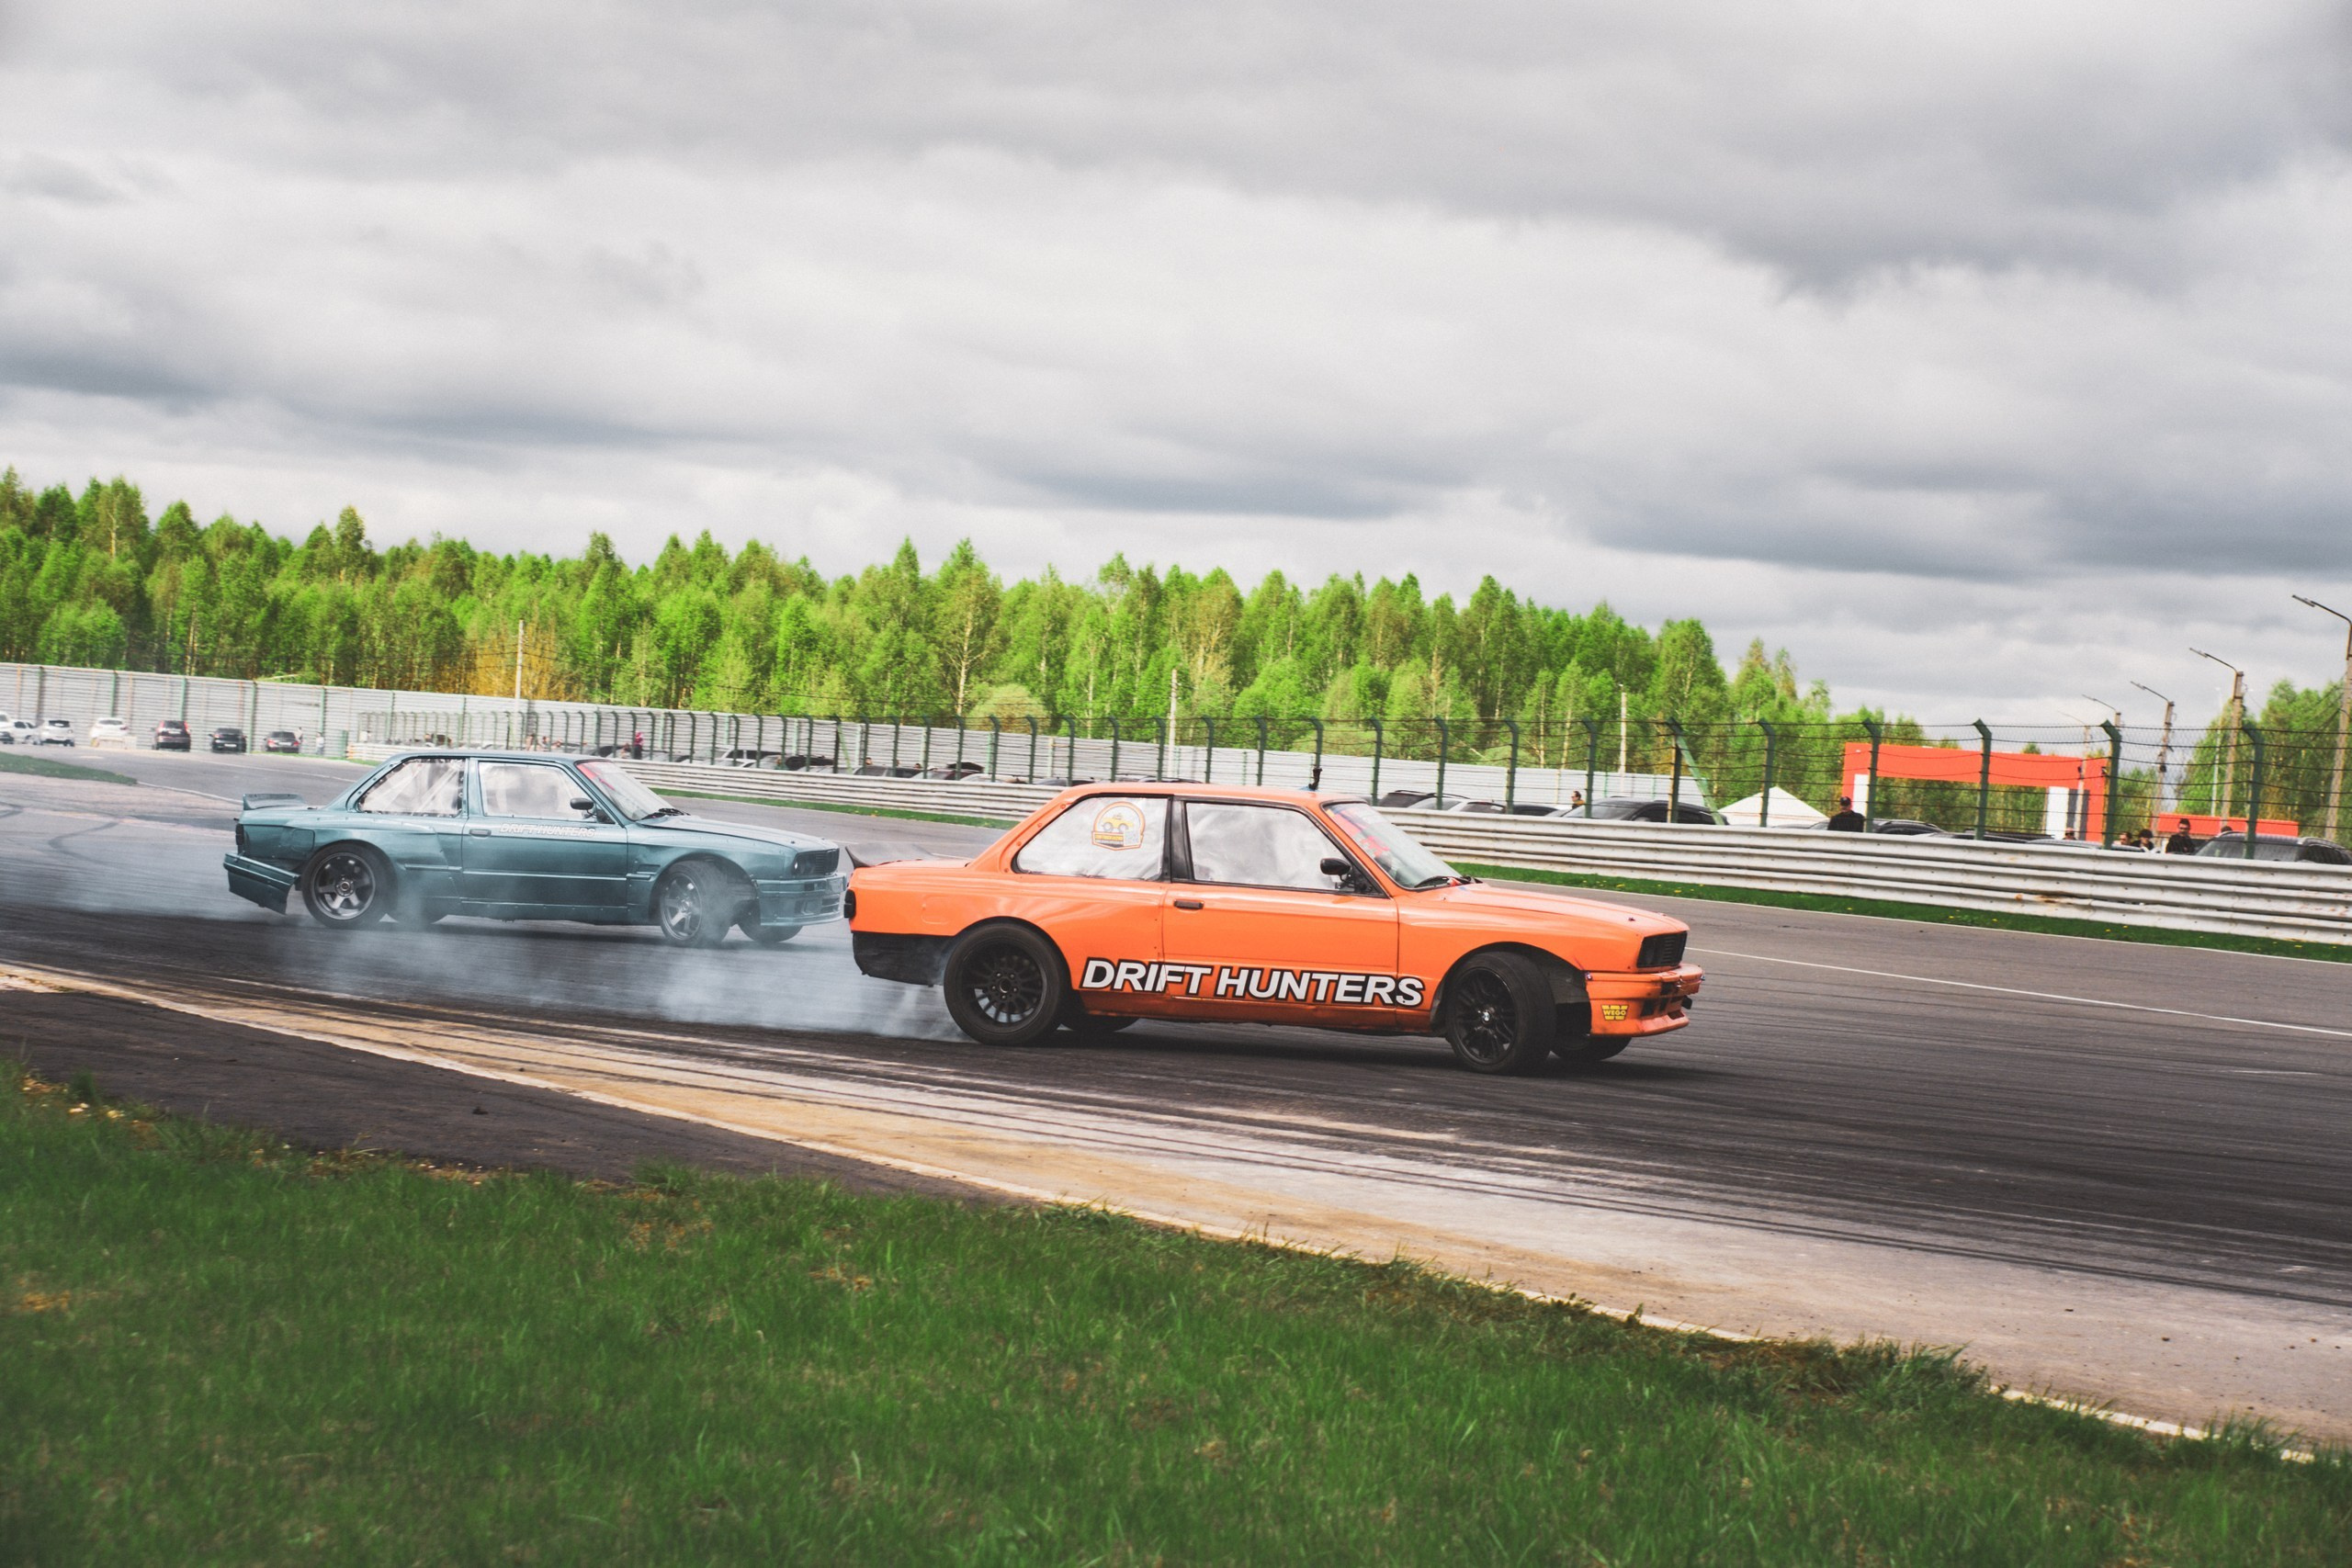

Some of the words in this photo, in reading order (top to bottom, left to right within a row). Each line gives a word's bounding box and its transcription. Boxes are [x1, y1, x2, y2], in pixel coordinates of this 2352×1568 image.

[500, 823, 536, 834] DRIFT
[537, 825, 596, 837] HUNTERS
[1081, 958, 1213, 996] DRIFT
[1215, 967, 1424, 1007] HUNTERS
